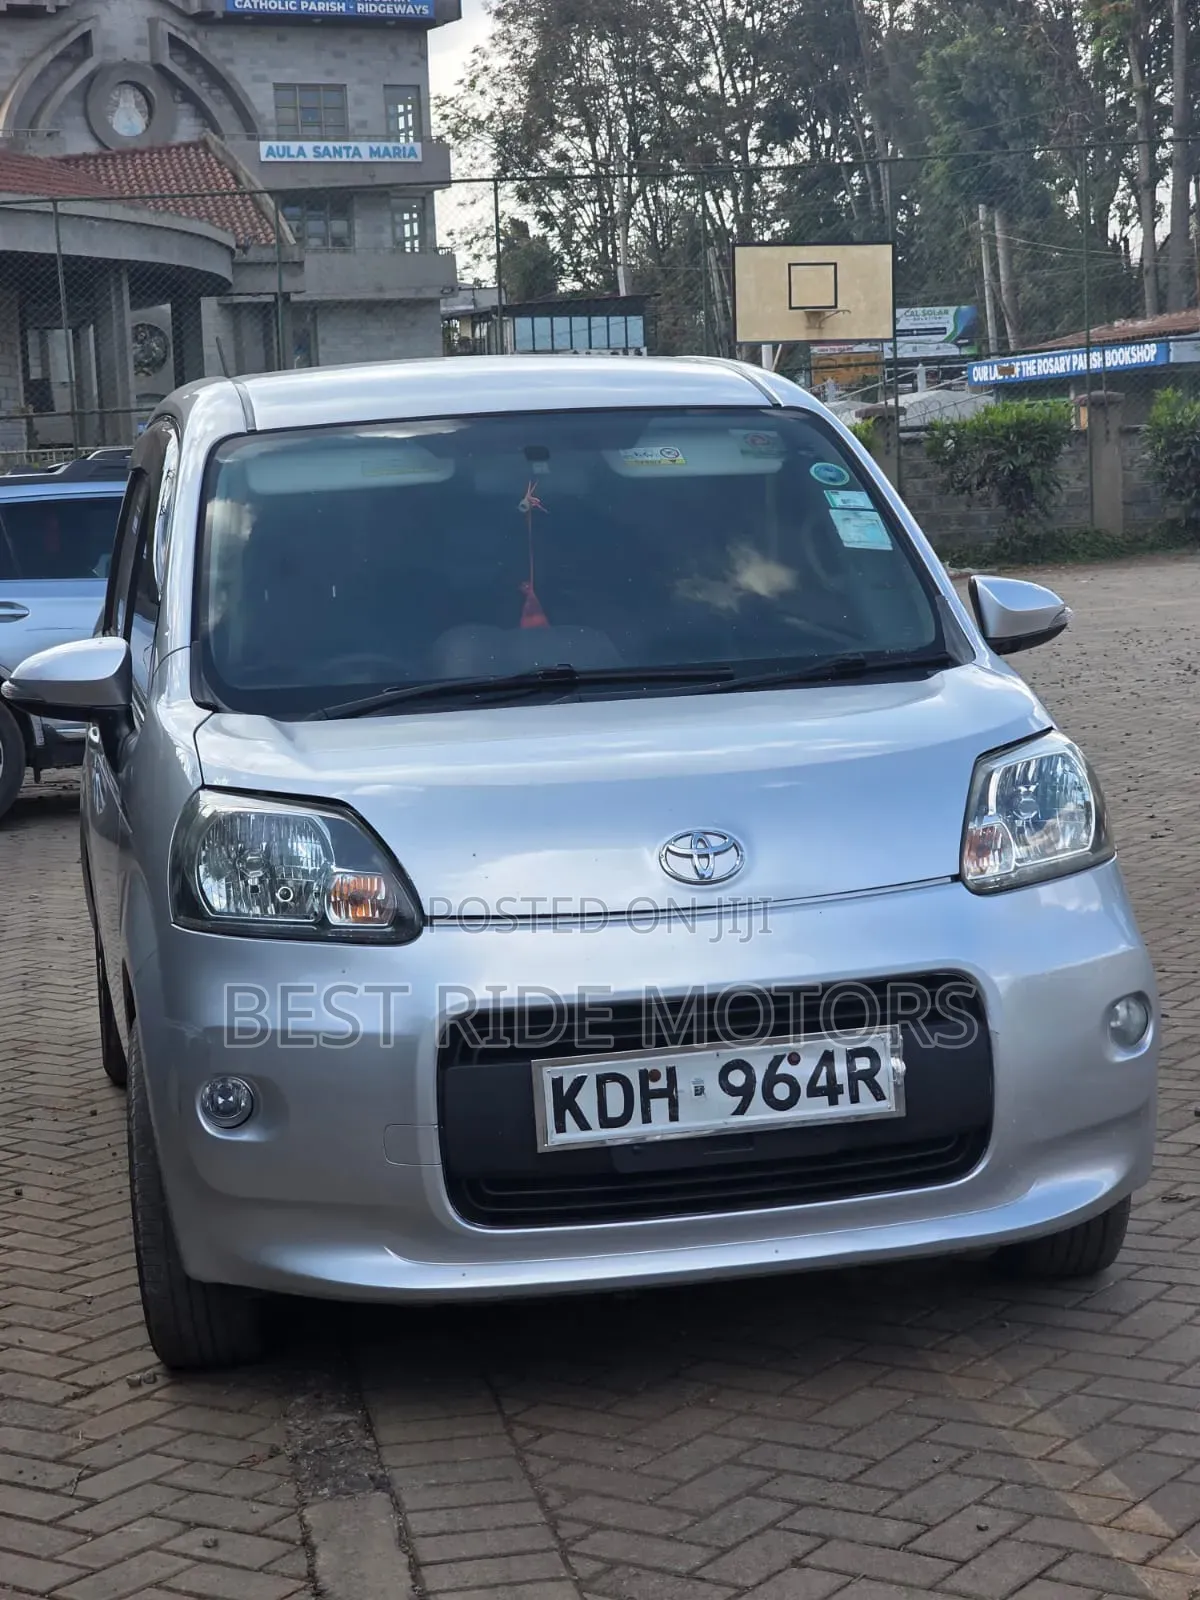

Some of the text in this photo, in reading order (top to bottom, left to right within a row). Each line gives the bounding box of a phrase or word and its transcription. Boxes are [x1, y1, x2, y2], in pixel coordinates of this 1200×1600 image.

[234, 0, 298, 11] CATHOLIC
[300, 2, 346, 13] PARISH
[356, 4, 430, 15] RIDGEWAYS
[265, 146, 418, 159] AULA SANTA MARIA
[921, 308, 949, 317] SOLAR
[972, 366, 989, 382] OUR
[1021, 358, 1037, 377] THE
[1037, 354, 1071, 375] ROSARY
[1105, 343, 1158, 367] BOOKSHOP
[551, 1046, 886, 1134] KDH 964R
